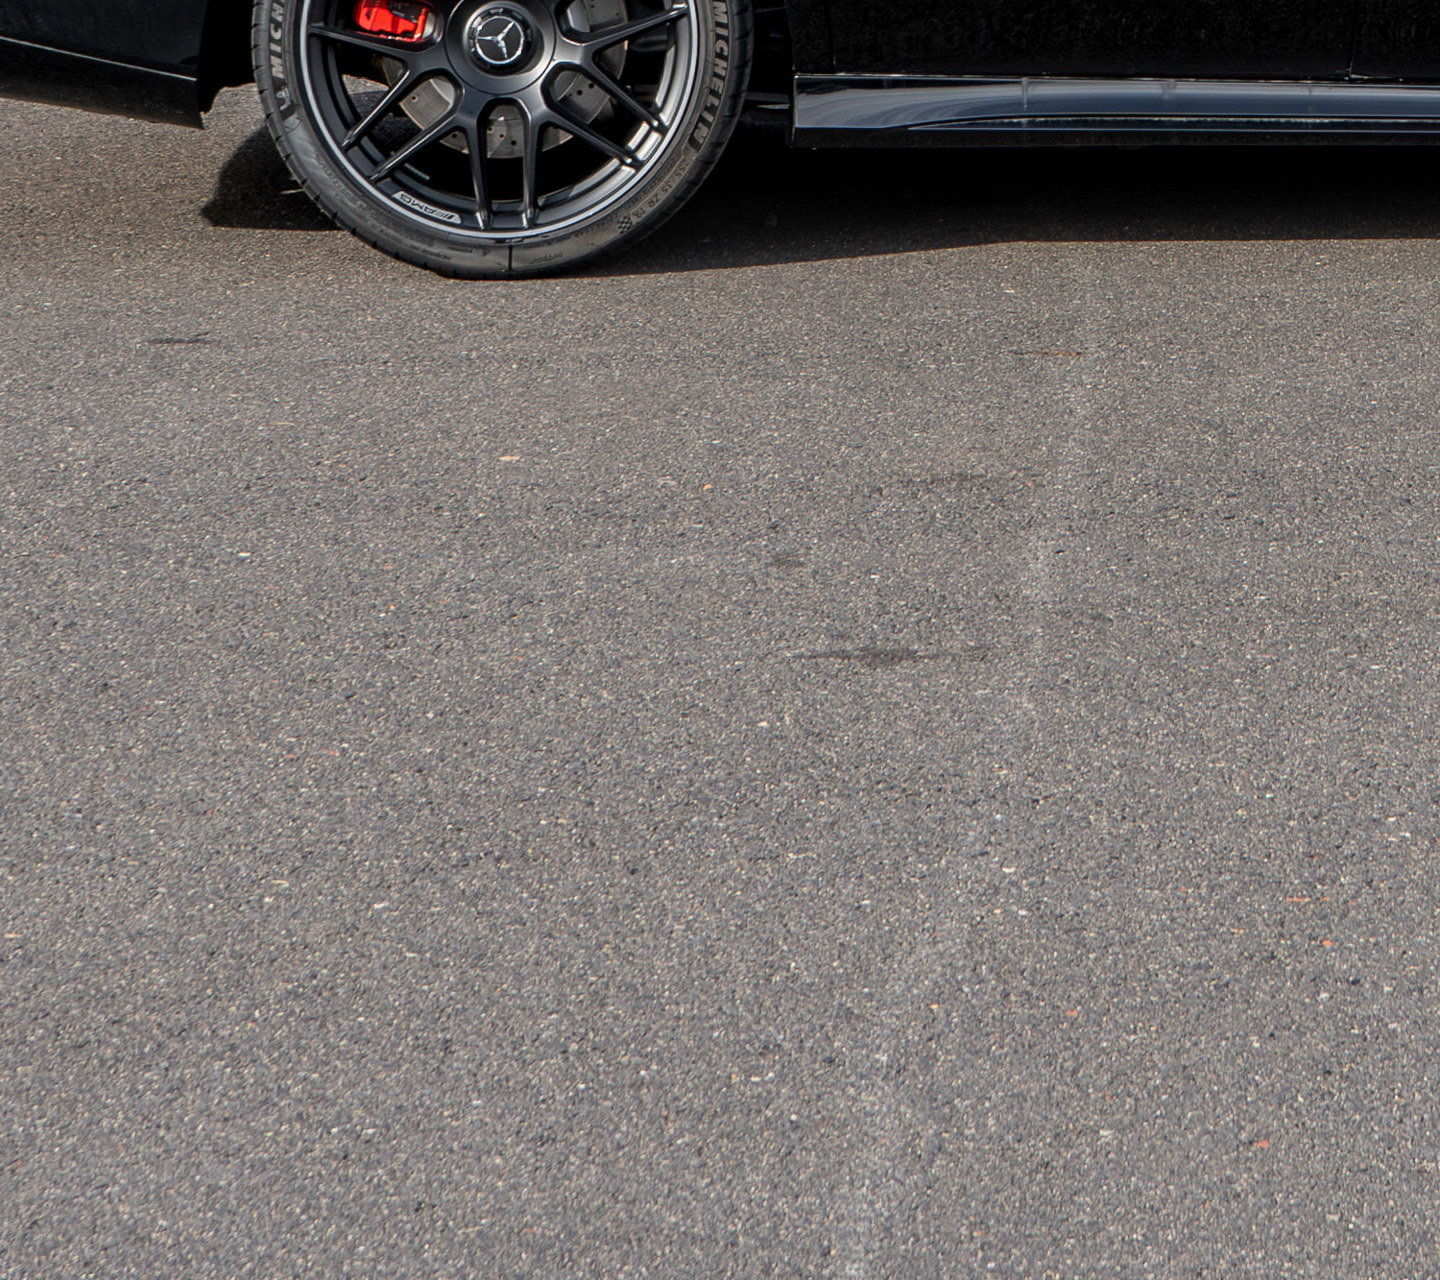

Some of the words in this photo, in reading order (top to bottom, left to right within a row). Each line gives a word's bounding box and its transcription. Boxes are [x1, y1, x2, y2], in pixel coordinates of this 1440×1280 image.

[691, 1, 729, 148] MICHELIN
[399, 193, 436, 215] AMG
[647, 192, 661, 208] ZR
